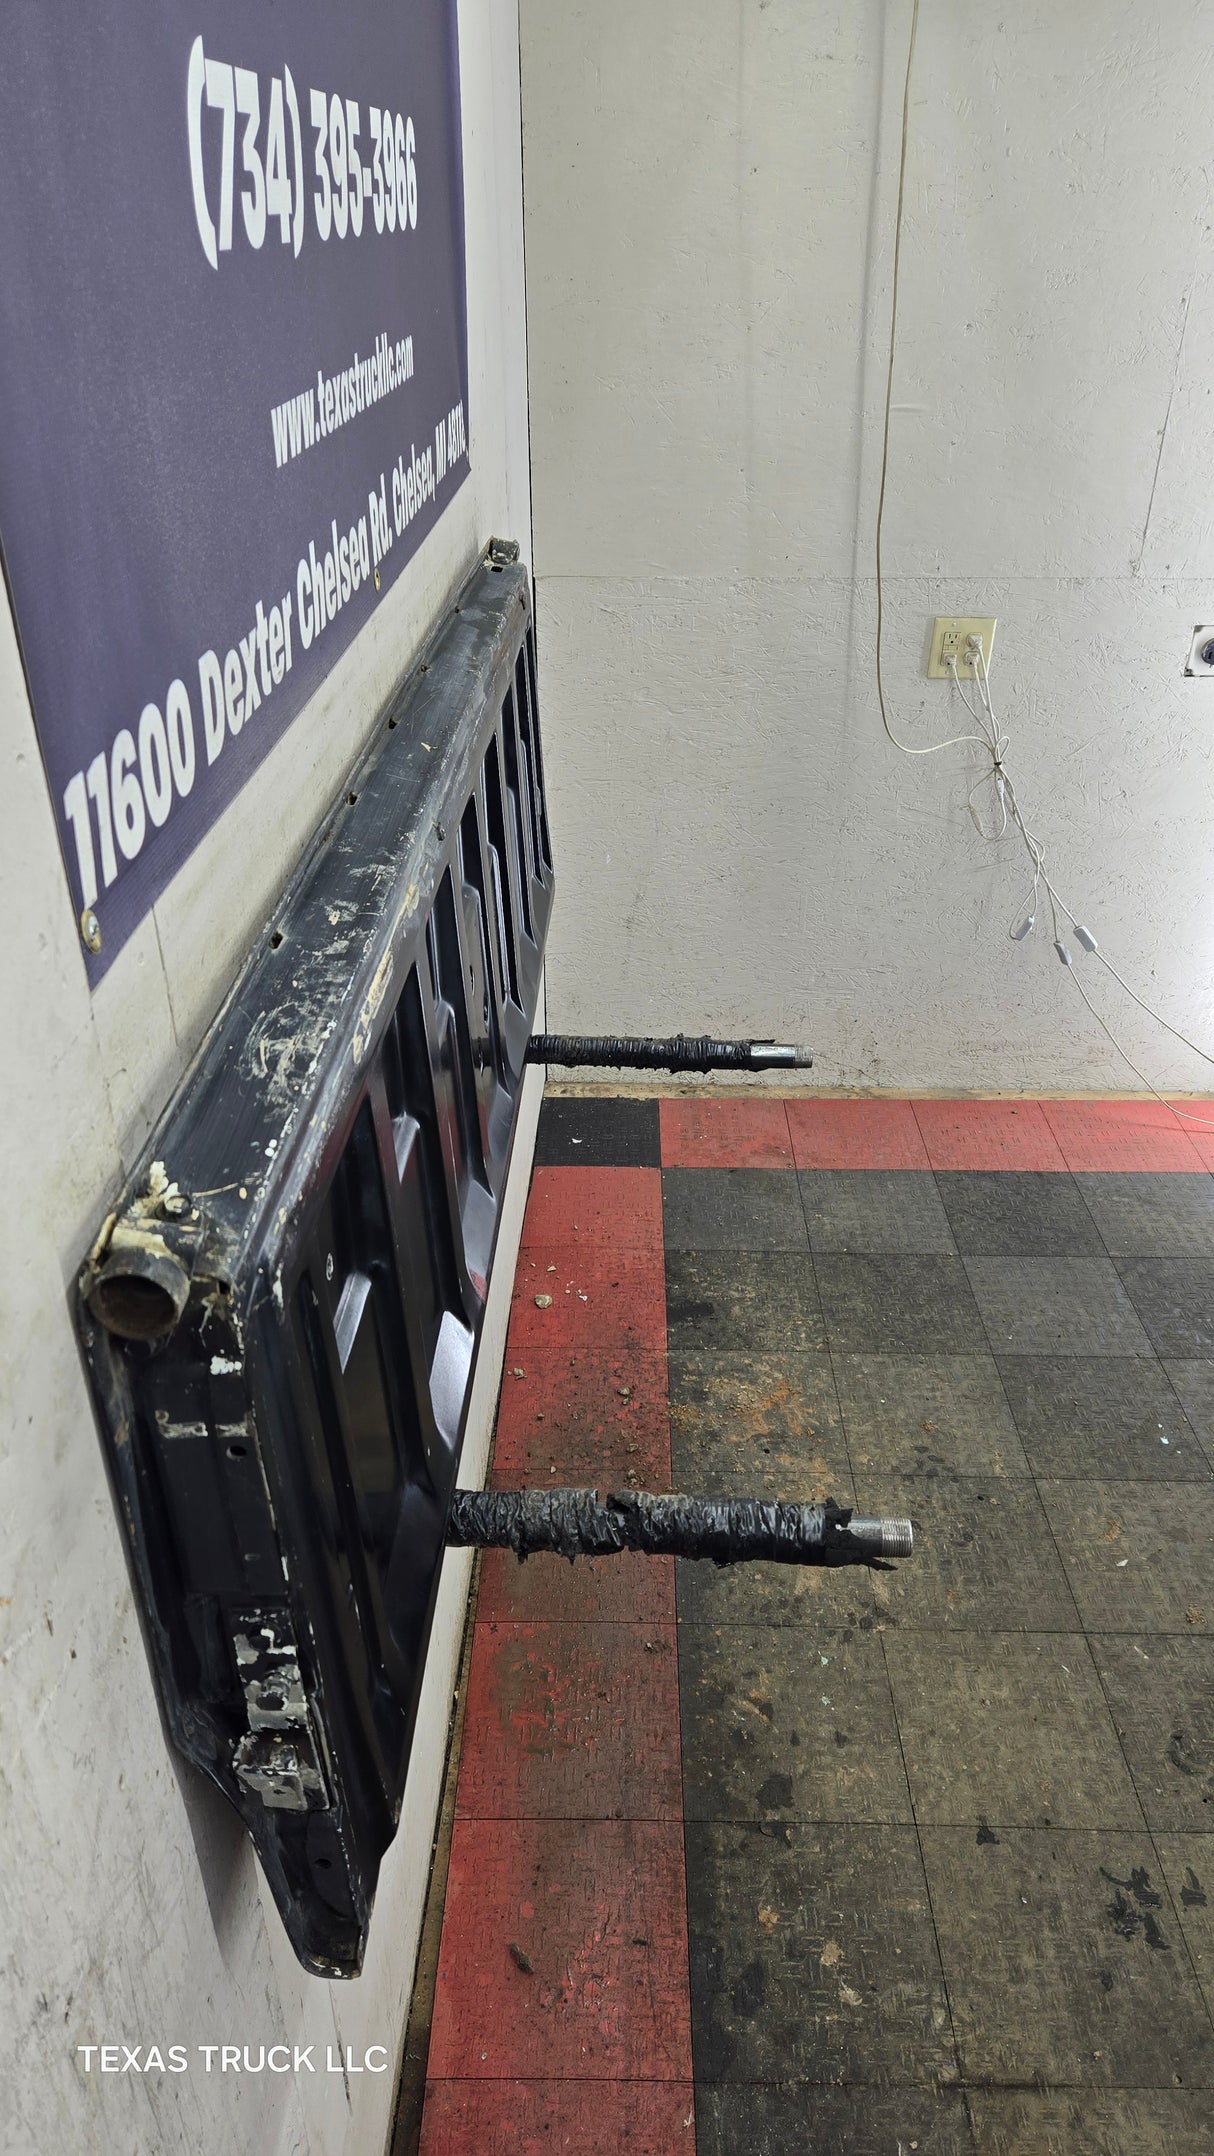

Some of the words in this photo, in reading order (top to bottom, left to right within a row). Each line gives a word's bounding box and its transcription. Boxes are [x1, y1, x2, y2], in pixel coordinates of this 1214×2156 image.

[187, 34, 304, 270] (734)
[310, 87, 418, 241] 395-3966
[271, 331, 414, 469] www.texastruckllc.com
[63, 678, 196, 909] 11600
[198, 590, 293, 767] Dexter
[297, 515, 370, 650] Chelsea
[368, 472, 393, 568] Rd.
[392, 443, 436, 537] Chelsea,
[435, 418, 447, 484] MI
